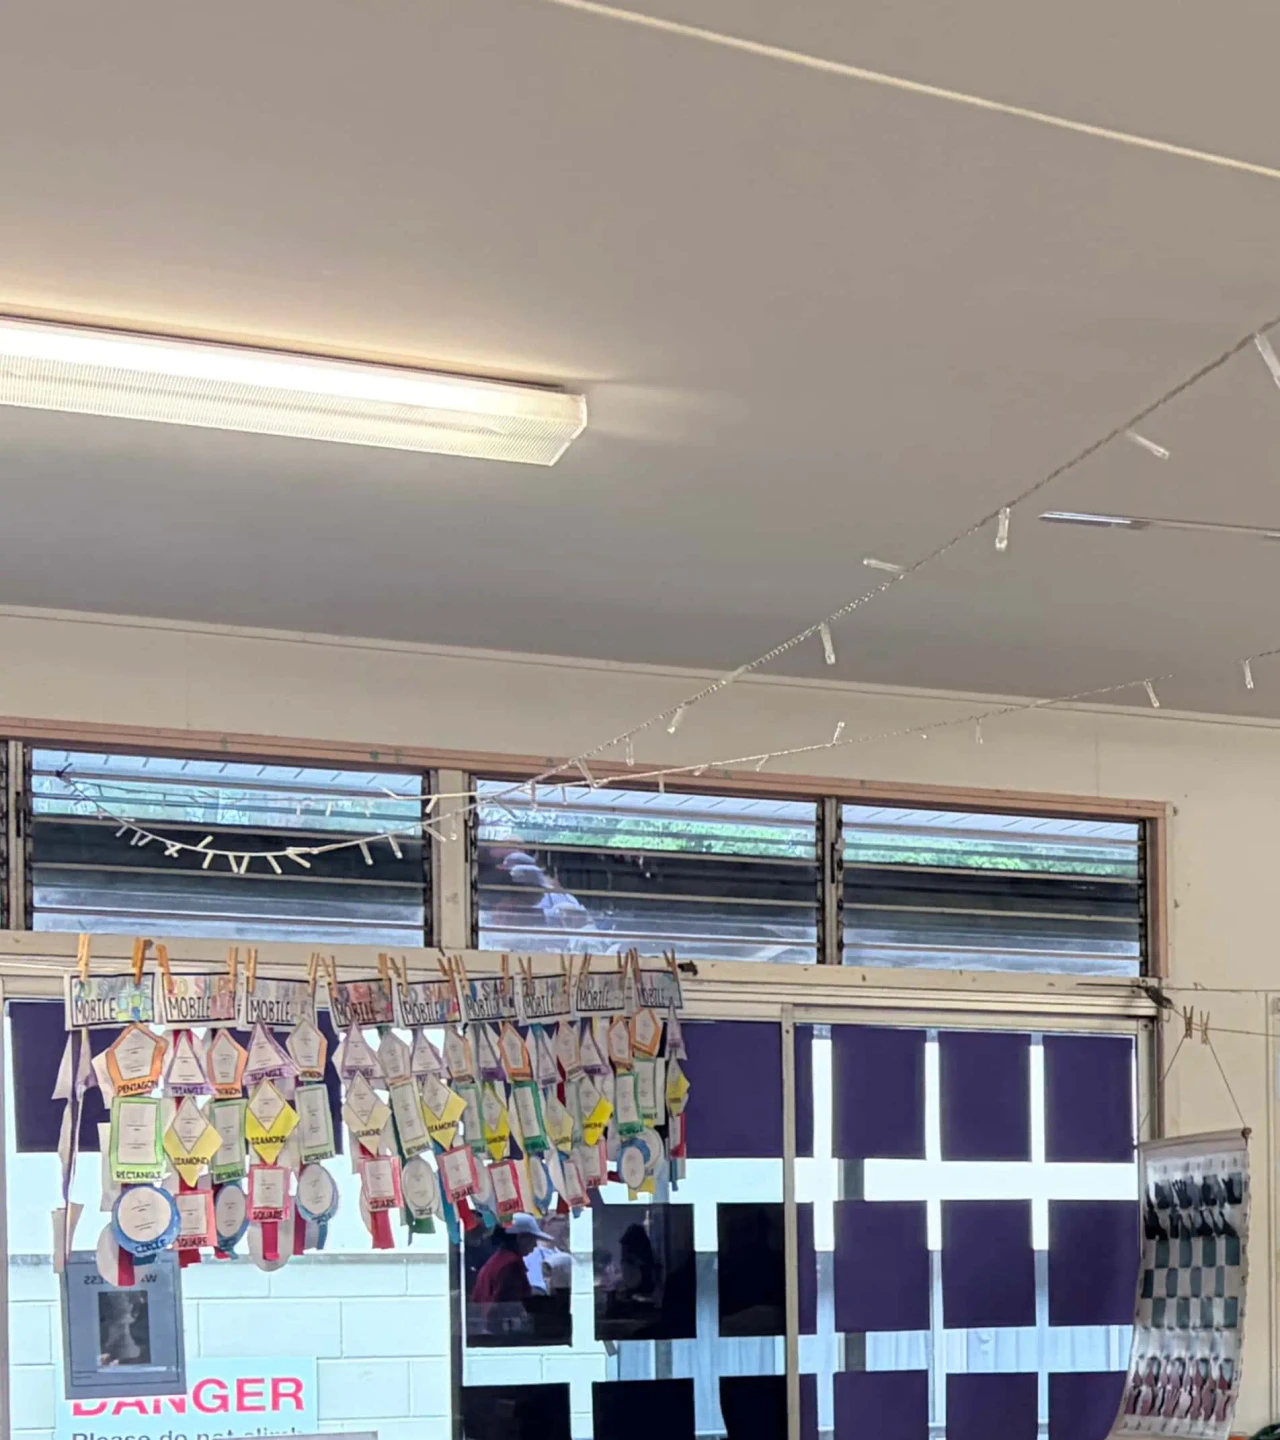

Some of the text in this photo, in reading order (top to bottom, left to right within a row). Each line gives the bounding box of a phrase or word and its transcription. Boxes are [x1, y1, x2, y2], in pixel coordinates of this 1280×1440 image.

[169, 997, 211, 1019] MOBILE
[579, 988, 610, 1009] MOBILE
[75, 998, 116, 1021] MOBILE
[251, 1001, 291, 1023] MOBILE
[335, 1001, 377, 1027] MOBILE
[404, 1000, 441, 1025] MOBILE
[117, 1080, 159, 1095] PENTAGON
[115, 1171, 162, 1180] RECTANGLE
[252, 1209, 283, 1220] SQUARE
[135, 1239, 167, 1254] CIRCLE
